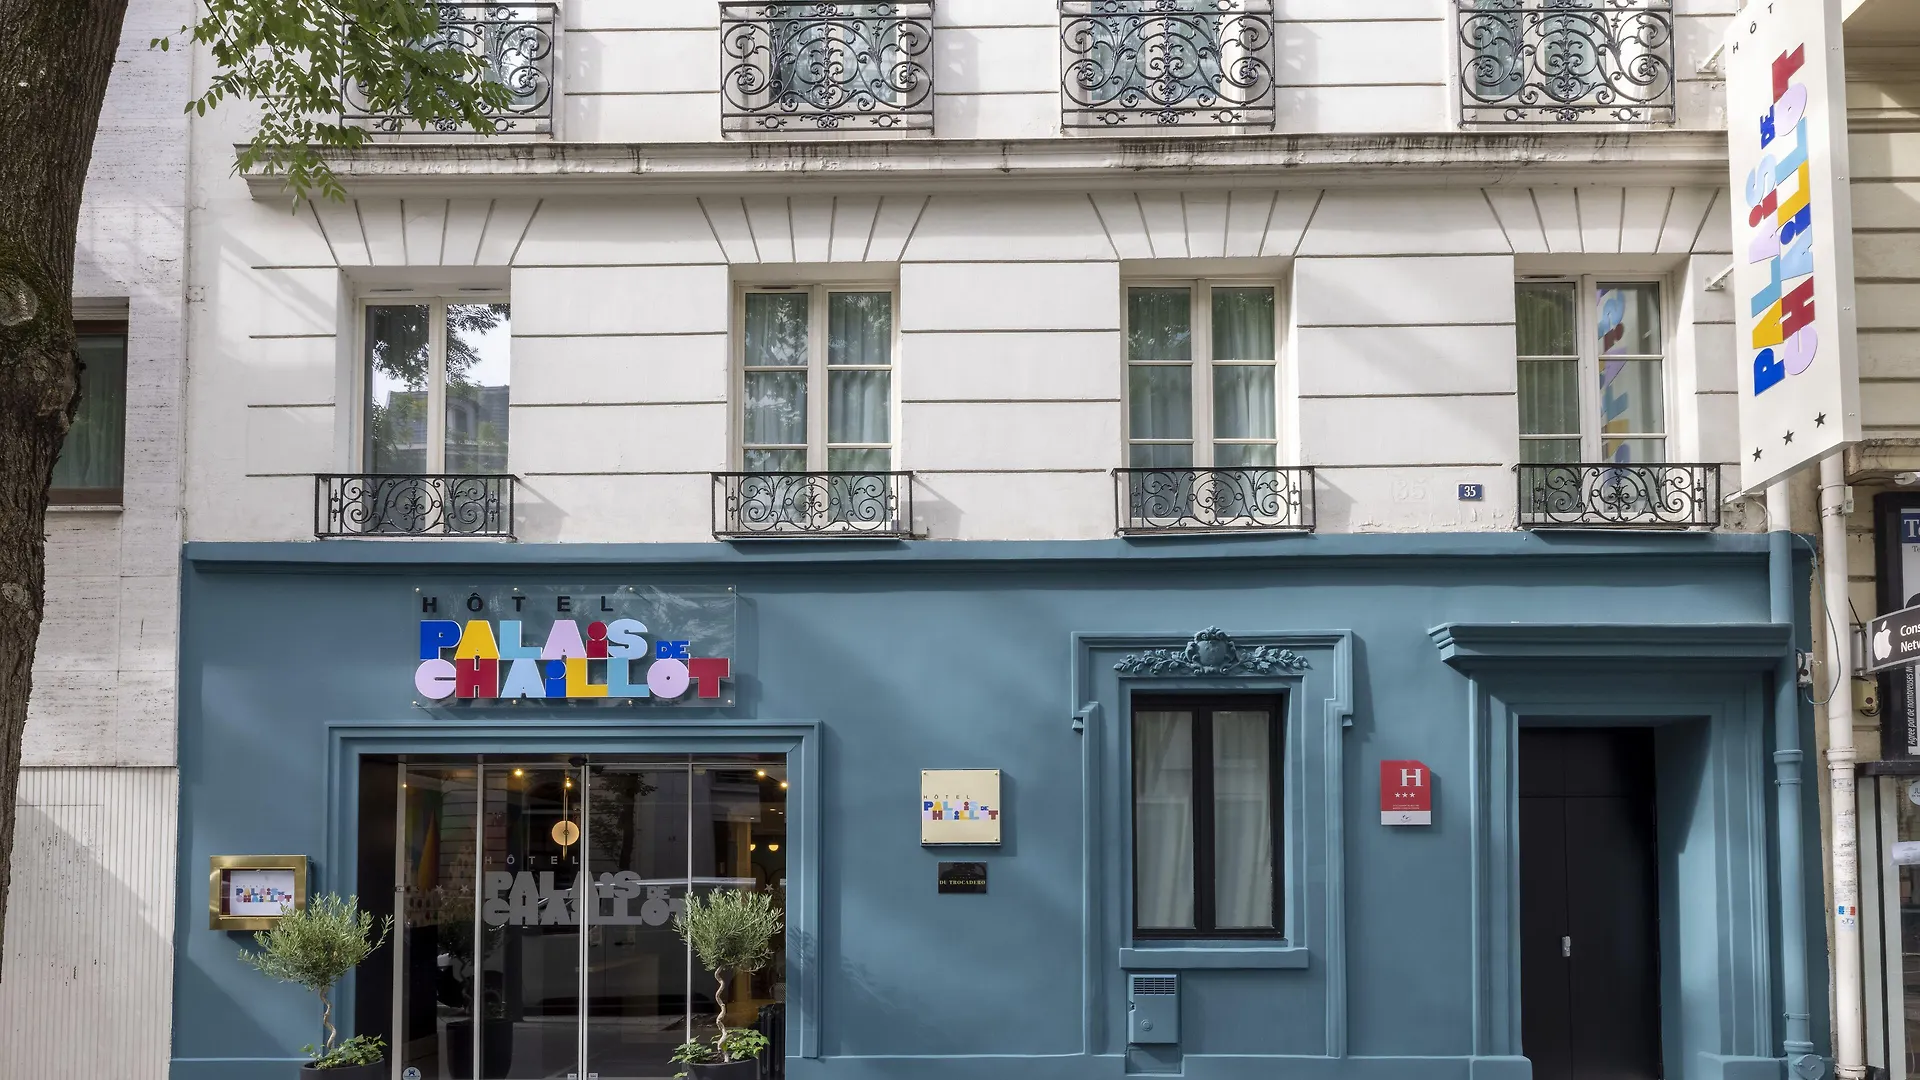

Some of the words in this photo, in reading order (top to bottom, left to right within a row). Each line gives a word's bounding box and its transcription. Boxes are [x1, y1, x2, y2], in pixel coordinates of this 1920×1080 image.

[1760, 104, 1774, 150] DE
[1464, 485, 1476, 497] 35
[1904, 519, 1920, 538] T
[422, 592, 613, 612] HÔTEL
[656, 640, 690, 659] DE
[1400, 768, 1423, 787] H
[484, 854, 579, 865] HÔTEL
[647, 886, 670, 899] DE
